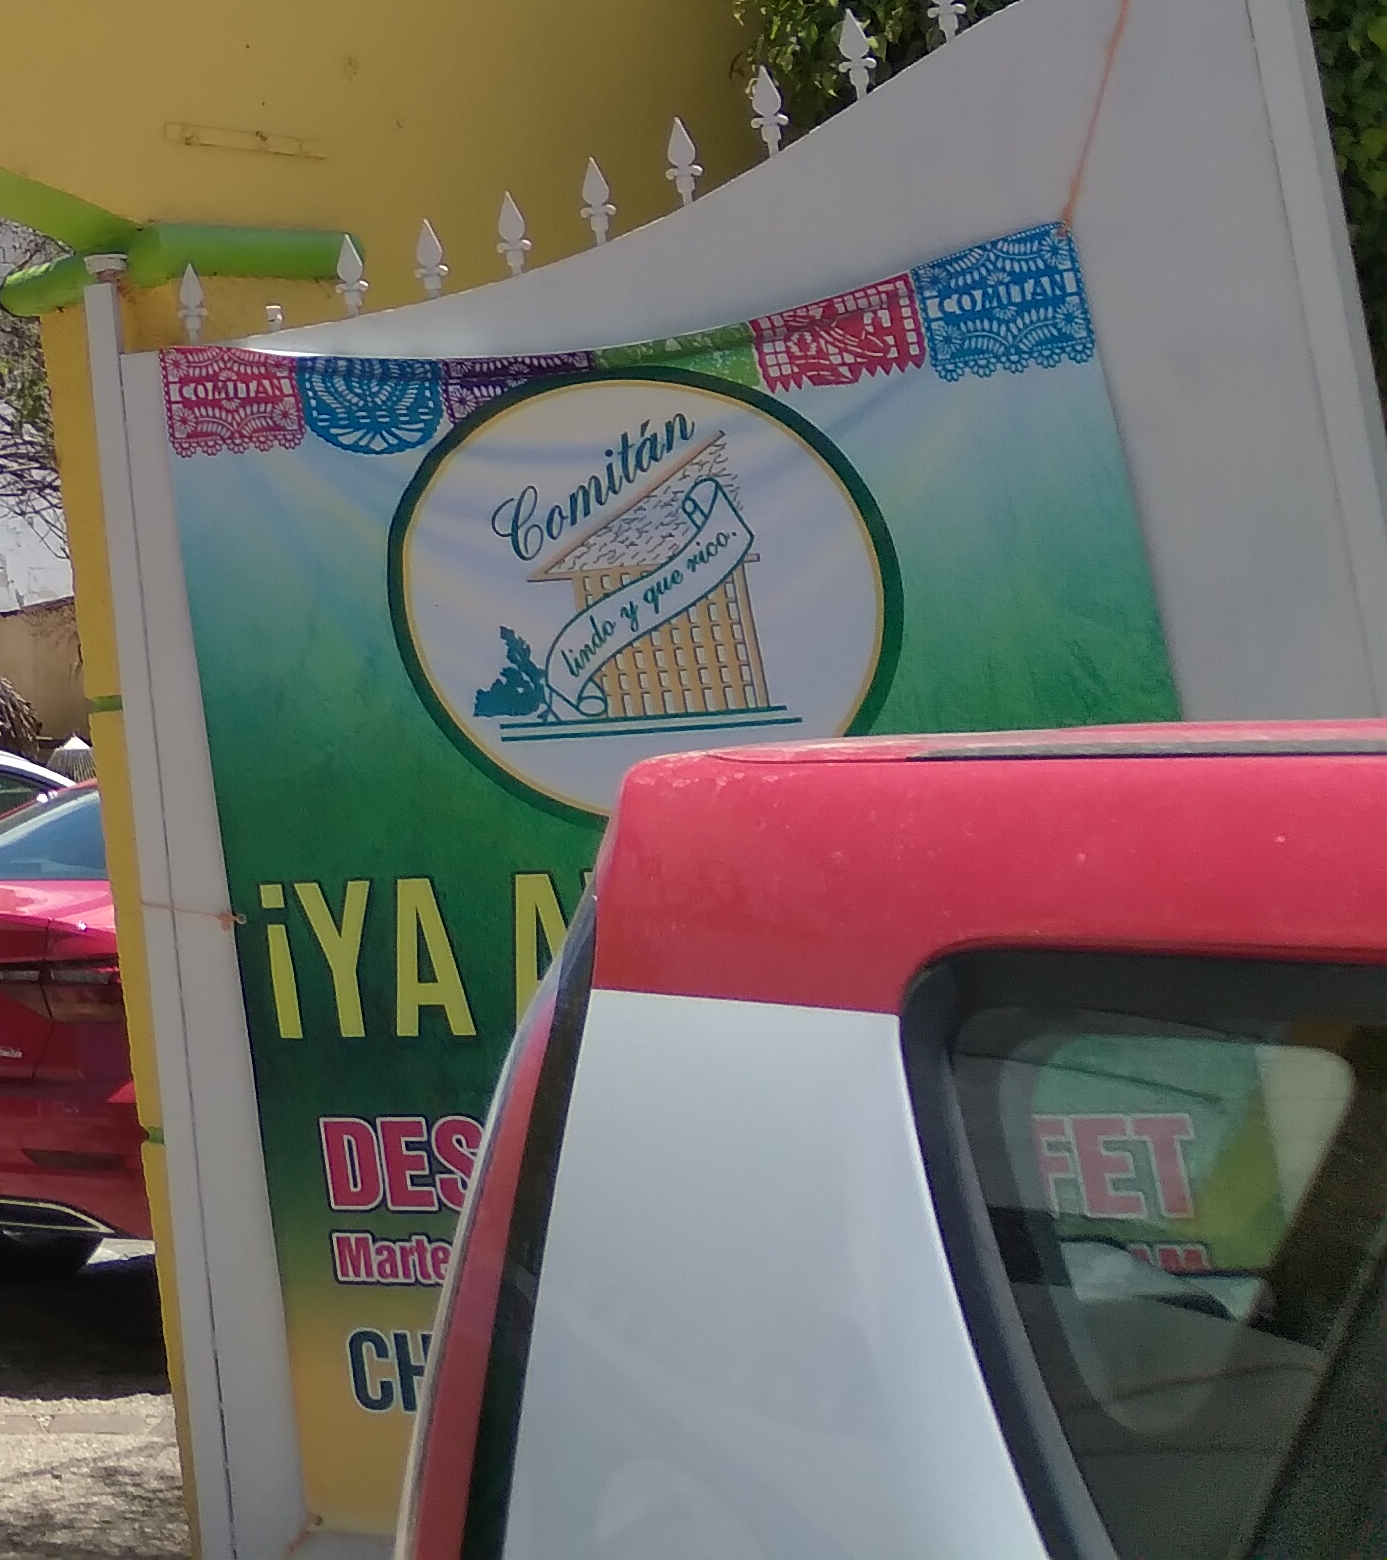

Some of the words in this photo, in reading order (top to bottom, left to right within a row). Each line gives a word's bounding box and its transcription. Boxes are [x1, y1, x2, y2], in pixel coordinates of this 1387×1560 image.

[491, 413, 695, 561] Comitán
[561, 615, 616, 678] lindo
[620, 600, 639, 633] y
[643, 569, 683, 614] que
[319, 1115, 484, 1212] DES
[332, 1232, 453, 1283] Marte
[347, 1327, 435, 1414] CH
